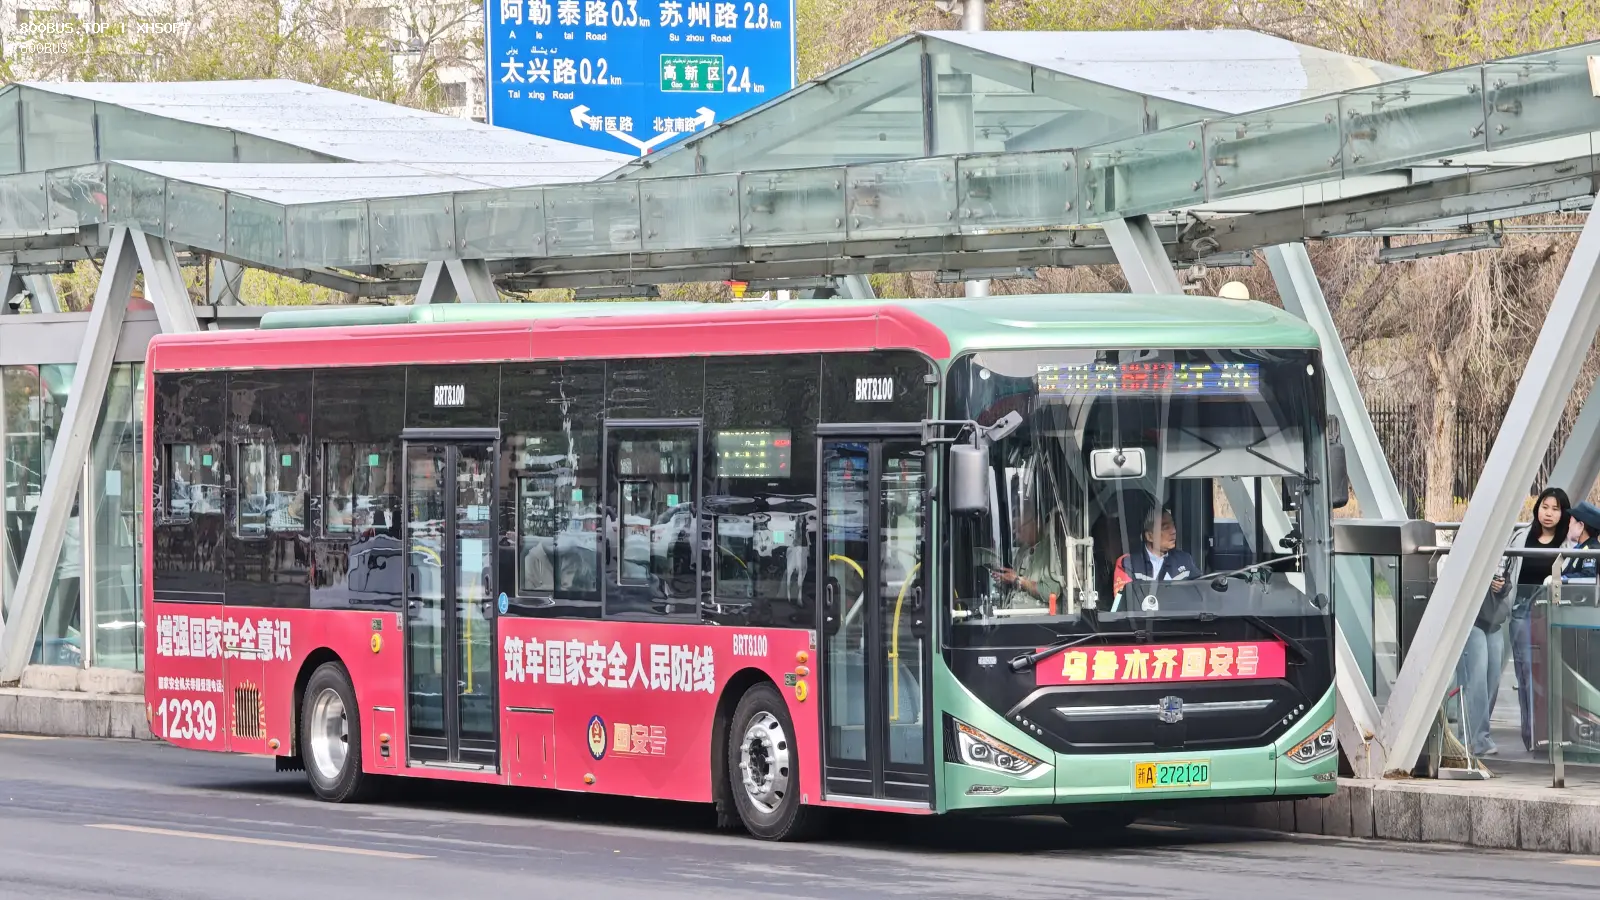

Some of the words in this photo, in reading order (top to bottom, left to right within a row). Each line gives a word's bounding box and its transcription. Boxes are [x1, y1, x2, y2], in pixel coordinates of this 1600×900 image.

[500, 0, 609, 27] 阿勒泰路
[611, 0, 638, 27] 0.3
[639, 16, 651, 28] km
[659, 1, 738, 28] 苏州路
[744, 2, 768, 29] 2.8
[770, 18, 782, 29] km
[509, 30, 517, 39] A
[585, 32, 607, 41] Road
[669, 33, 680, 42] Su
[686, 33, 705, 42] zhou
[711, 34, 732, 43] Road
[500, 57, 577, 84] 太兴路
[579, 57, 608, 85] 0.2
[610, 75, 622, 85] km
[663, 65, 720, 81] 高新区
[726, 65, 751, 93] 2.4
[753, 83, 765, 94] km
[508, 90, 521, 99] Tai
[528, 91, 545, 101] xing
[552, 91, 574, 100] Road
[589, 116, 633, 132] 新医路
[653, 117, 696, 132] 北京南路
[434, 384, 465, 406] BRT8100
[855, 377, 894, 401] BRT8100
[156, 614, 293, 662] 增强国家安全意识
[732, 633, 768, 658] BRT8100
[503, 635, 716, 695] 筑牢国家安全人民防线
[1062, 645, 1259, 681] 乌鲁木齐国安号
[158, 697, 217, 741] 12339
[612, 722, 668, 756] 国安号
[1160, 765, 1208, 784] 27212D
